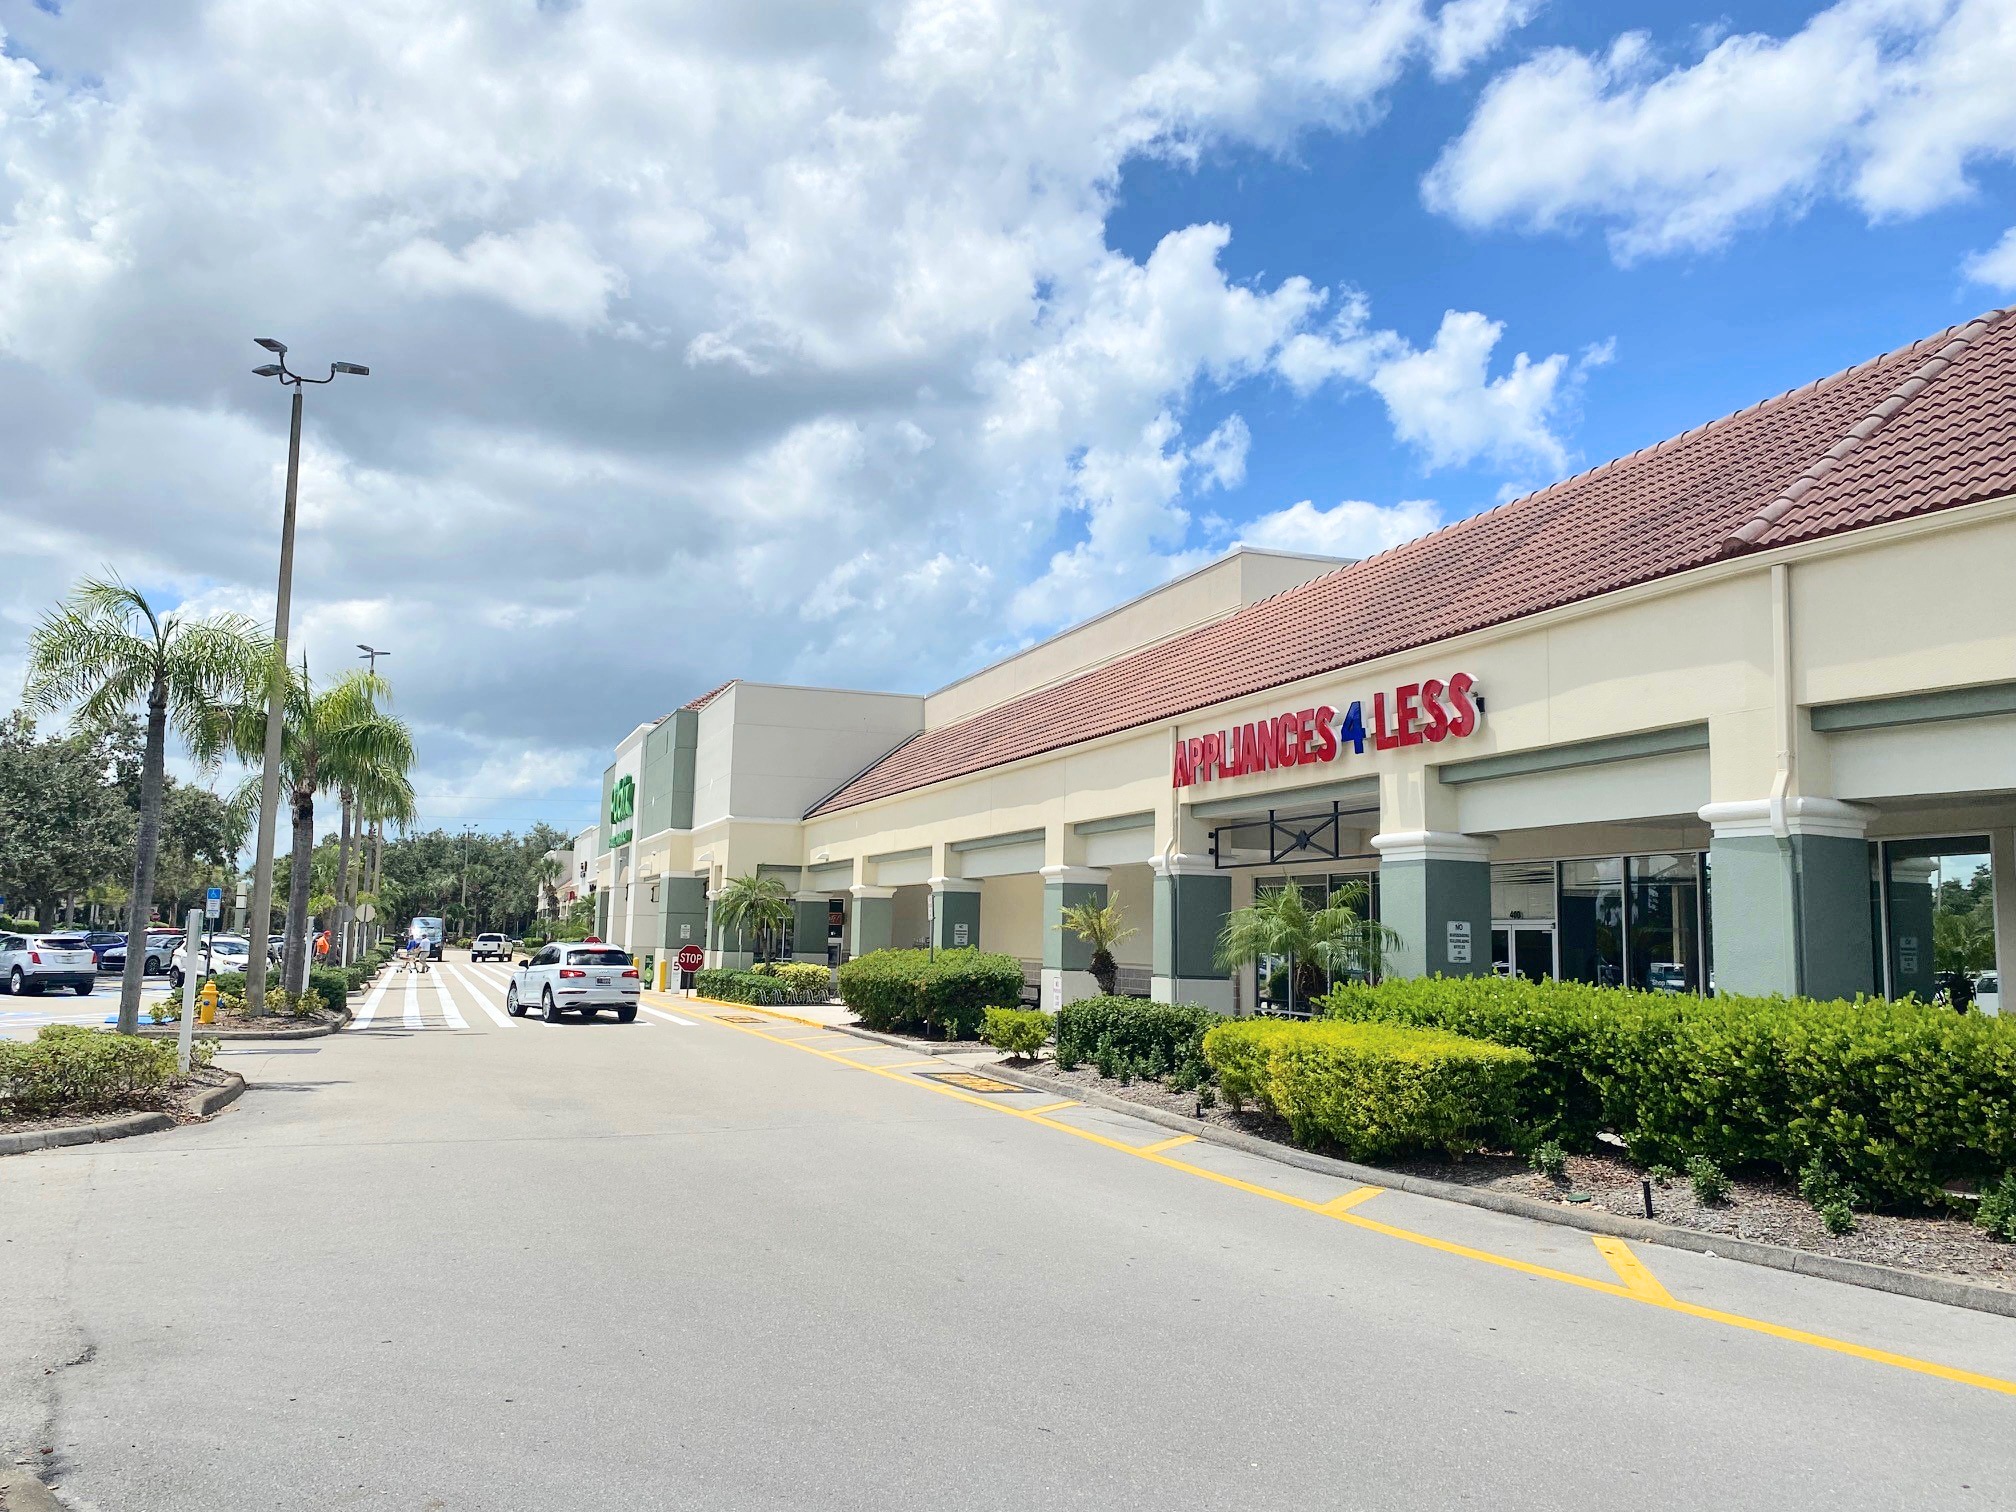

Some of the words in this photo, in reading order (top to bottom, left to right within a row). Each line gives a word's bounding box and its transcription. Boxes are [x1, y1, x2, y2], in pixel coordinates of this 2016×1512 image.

[1173, 705, 1340, 788] APPLIANCES
[1341, 701, 1366, 754] 4
[1374, 672, 1481, 751] LESS
[679, 953, 703, 964] STOP
